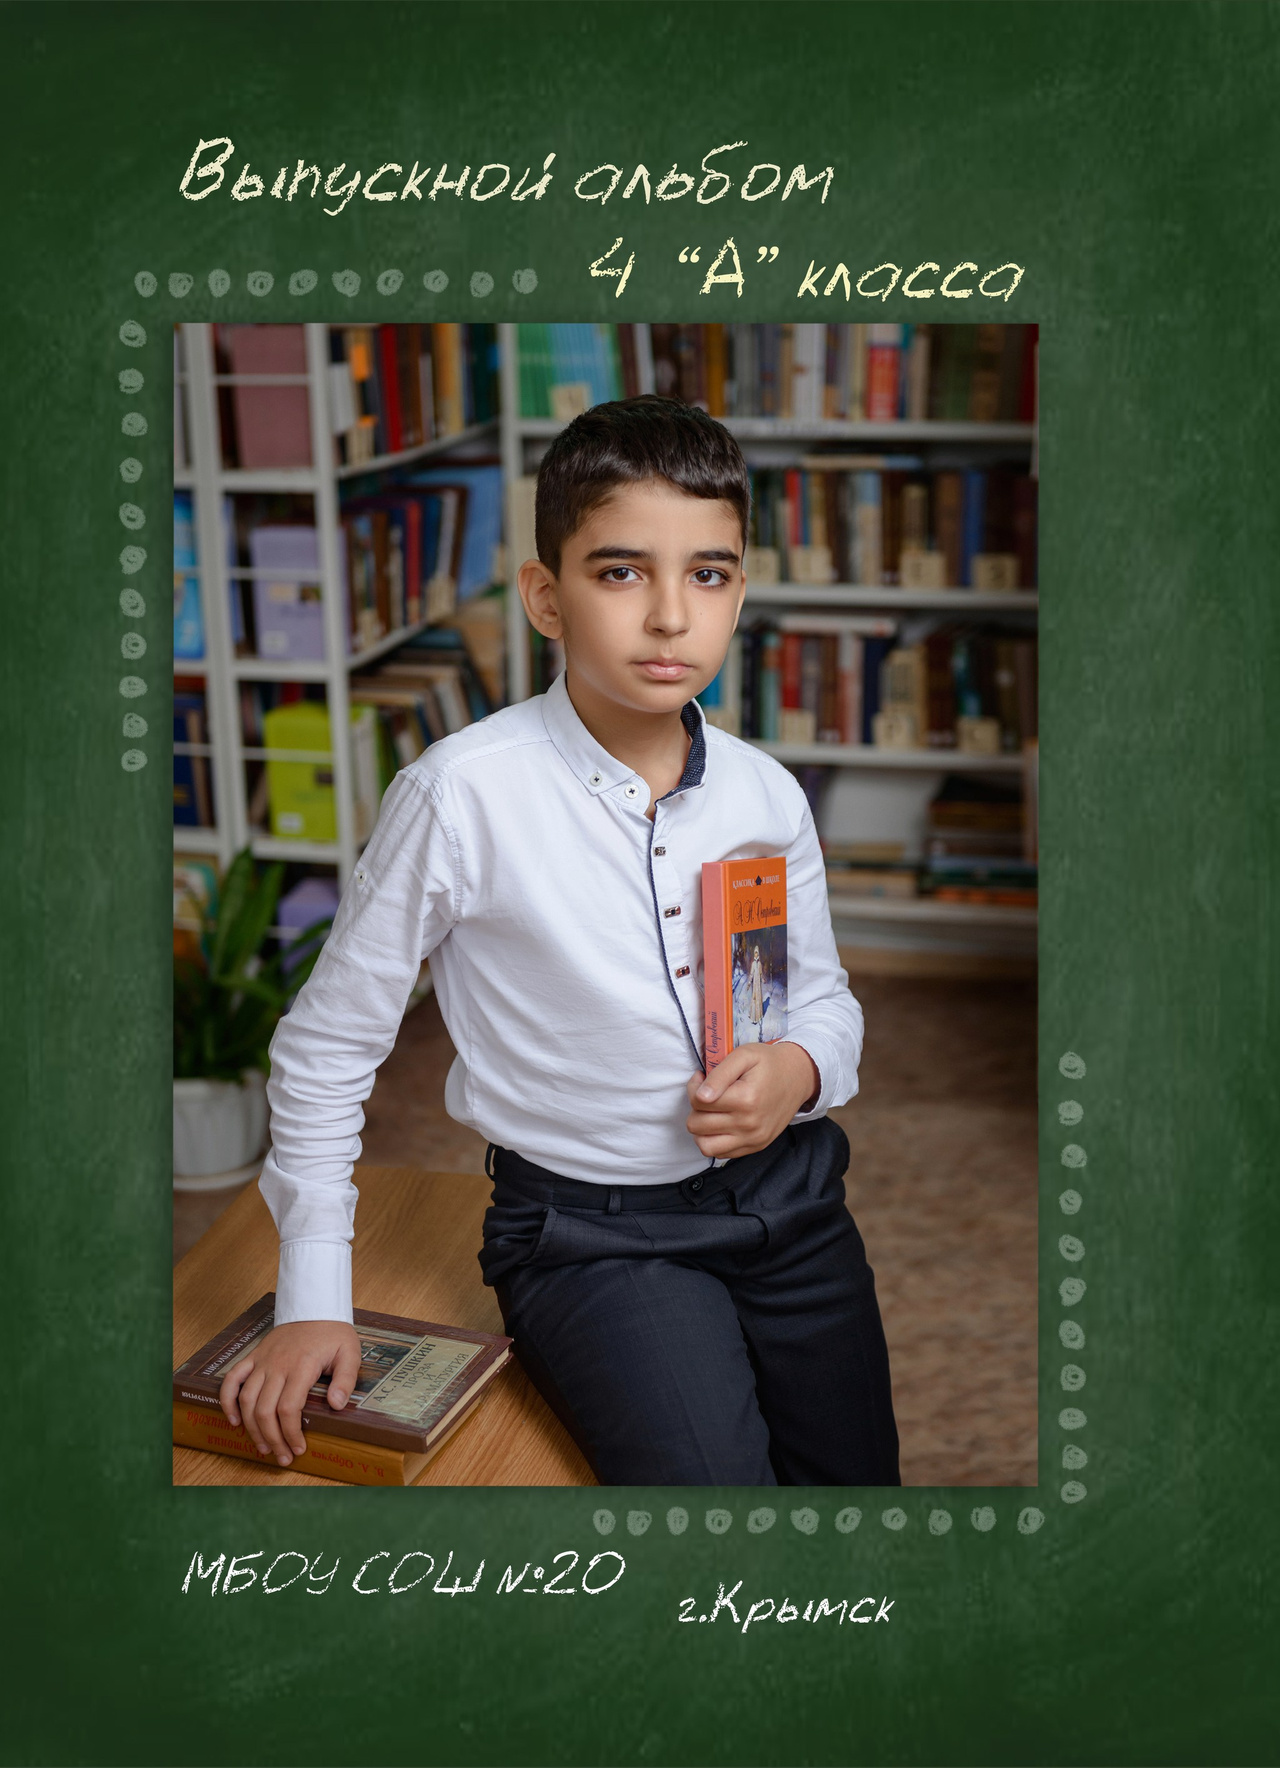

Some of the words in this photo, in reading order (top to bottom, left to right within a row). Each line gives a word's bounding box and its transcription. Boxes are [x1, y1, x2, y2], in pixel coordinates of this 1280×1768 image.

[395, 1343, 436, 1384] ПУШКИН
[403, 1362, 434, 1389] ПРОЗА
[311, 1451, 353, 1468] Обручев
[358, 1462, 369, 1473] А.
[374, 1466, 384, 1477] В.
